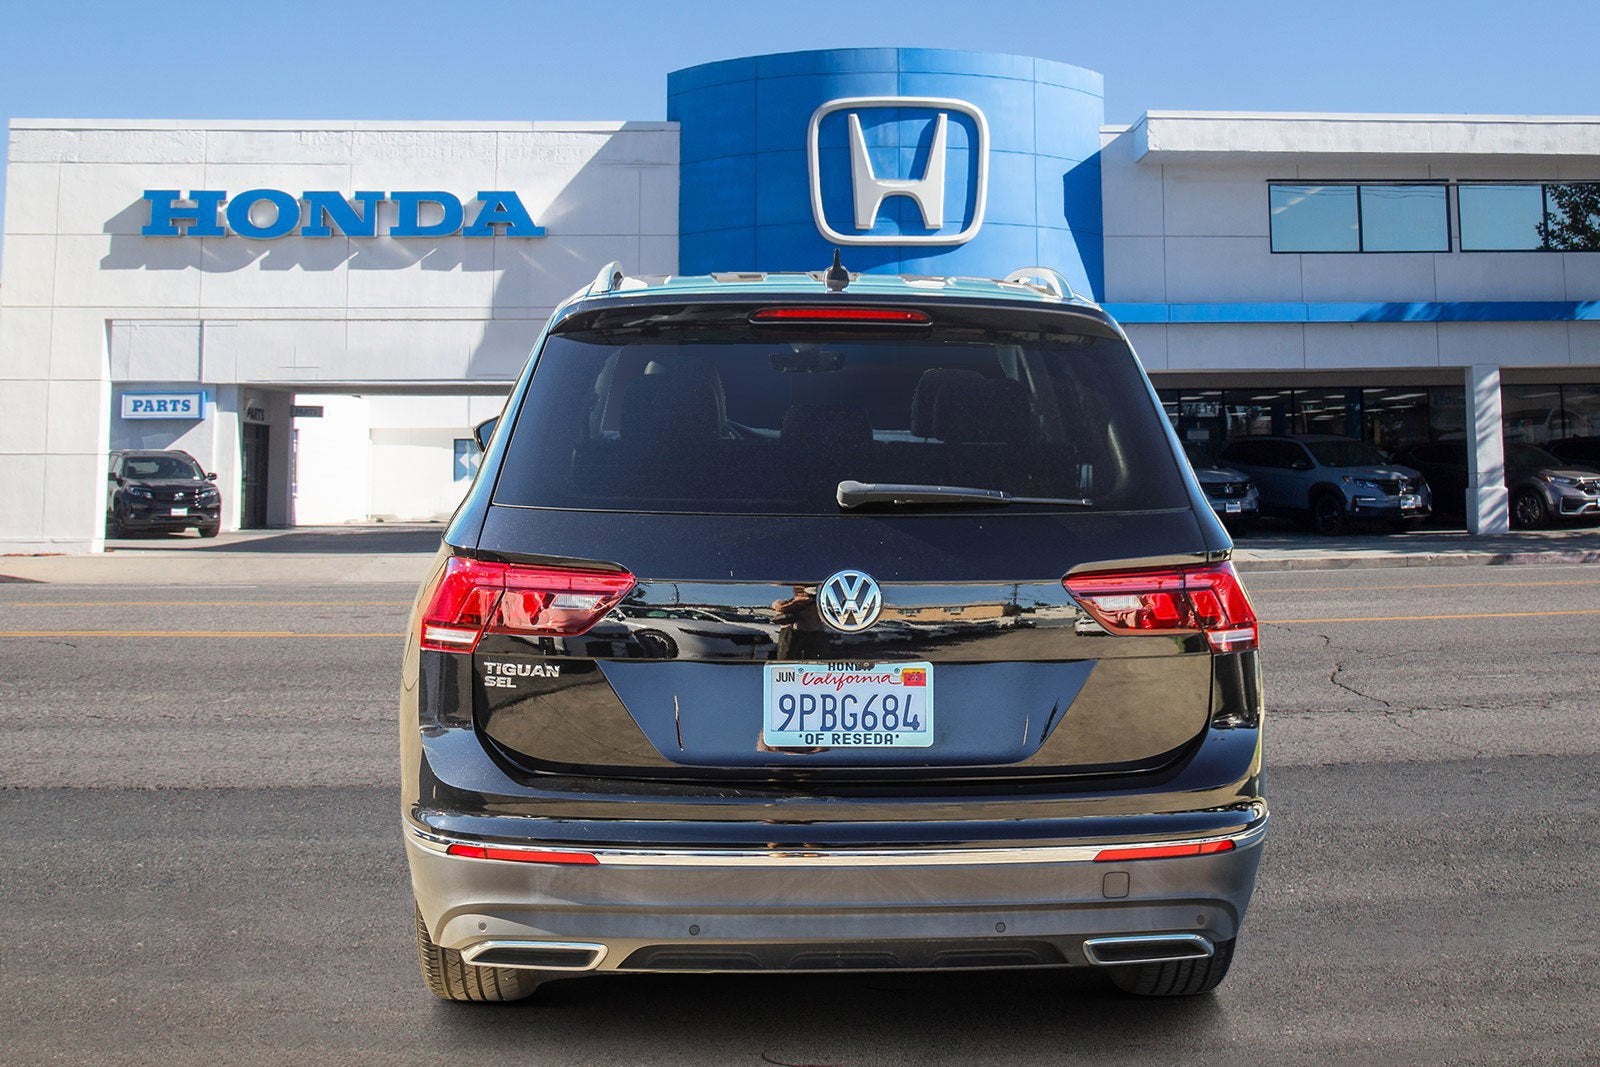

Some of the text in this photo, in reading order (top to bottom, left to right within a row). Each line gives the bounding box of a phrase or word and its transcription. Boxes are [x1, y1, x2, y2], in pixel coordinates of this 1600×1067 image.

[141, 188, 547, 240] HONDA
[131, 400, 191, 412] PARTS
[484, 661, 560, 678] TIGUAN
[828, 662, 872, 672] HON
[484, 676, 517, 688] SEL
[776, 672, 903, 691] JUN California
[778, 693, 921, 732] 9PBG684
[805, 733, 894, 745] OF RESEDA
